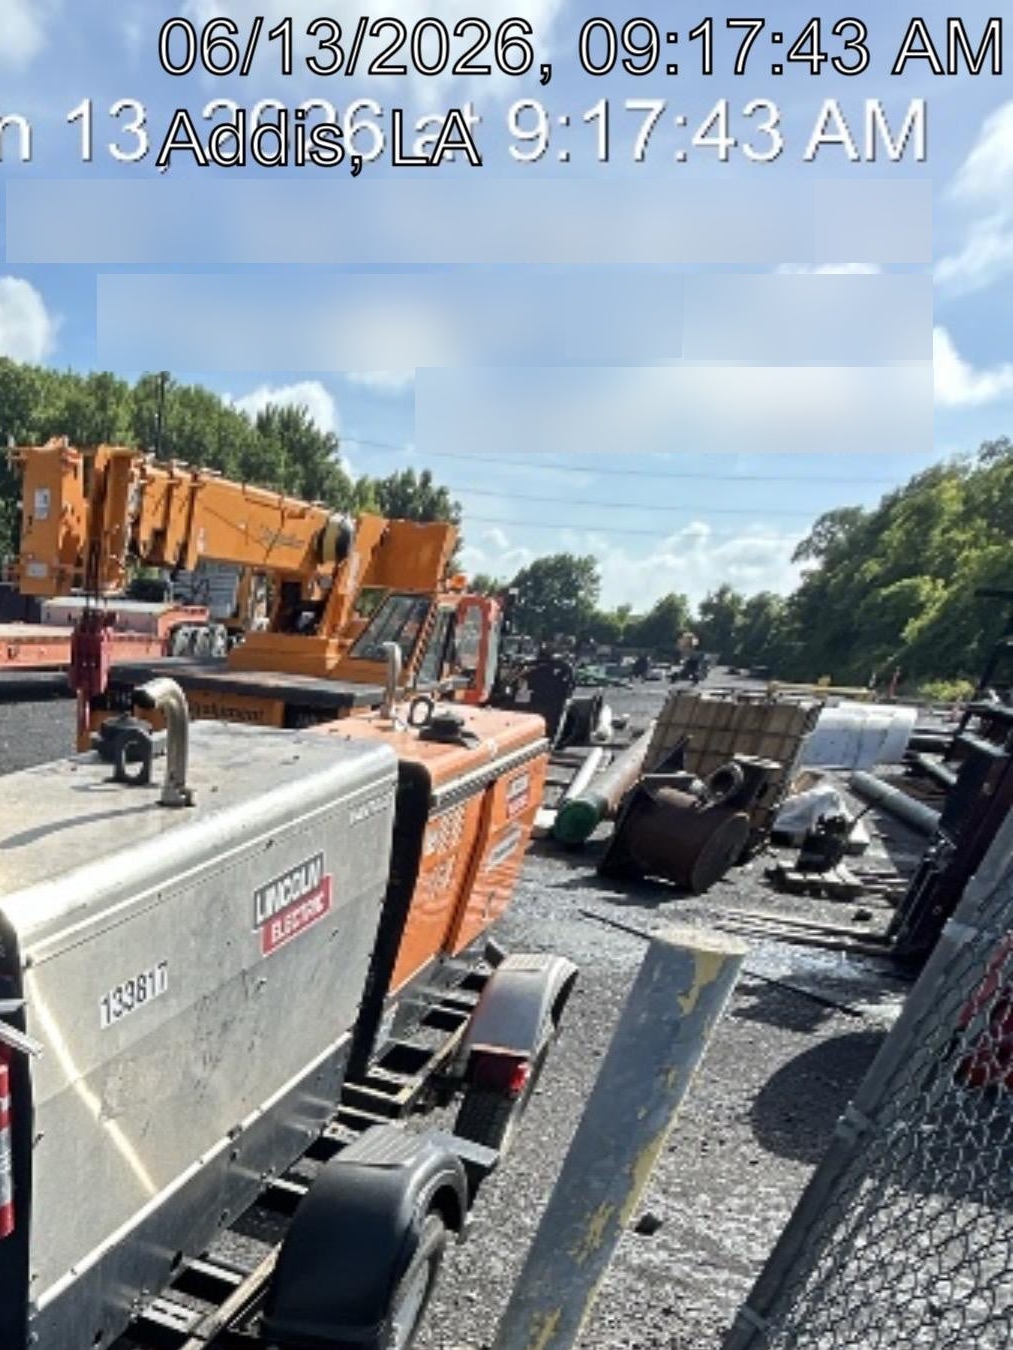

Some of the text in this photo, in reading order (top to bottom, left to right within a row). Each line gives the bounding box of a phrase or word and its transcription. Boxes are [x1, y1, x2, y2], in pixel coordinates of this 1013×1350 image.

[256, 857, 322, 925] LINCOLN
[271, 889, 325, 944] ELECTRIC
[100, 959, 169, 1026] 133817
